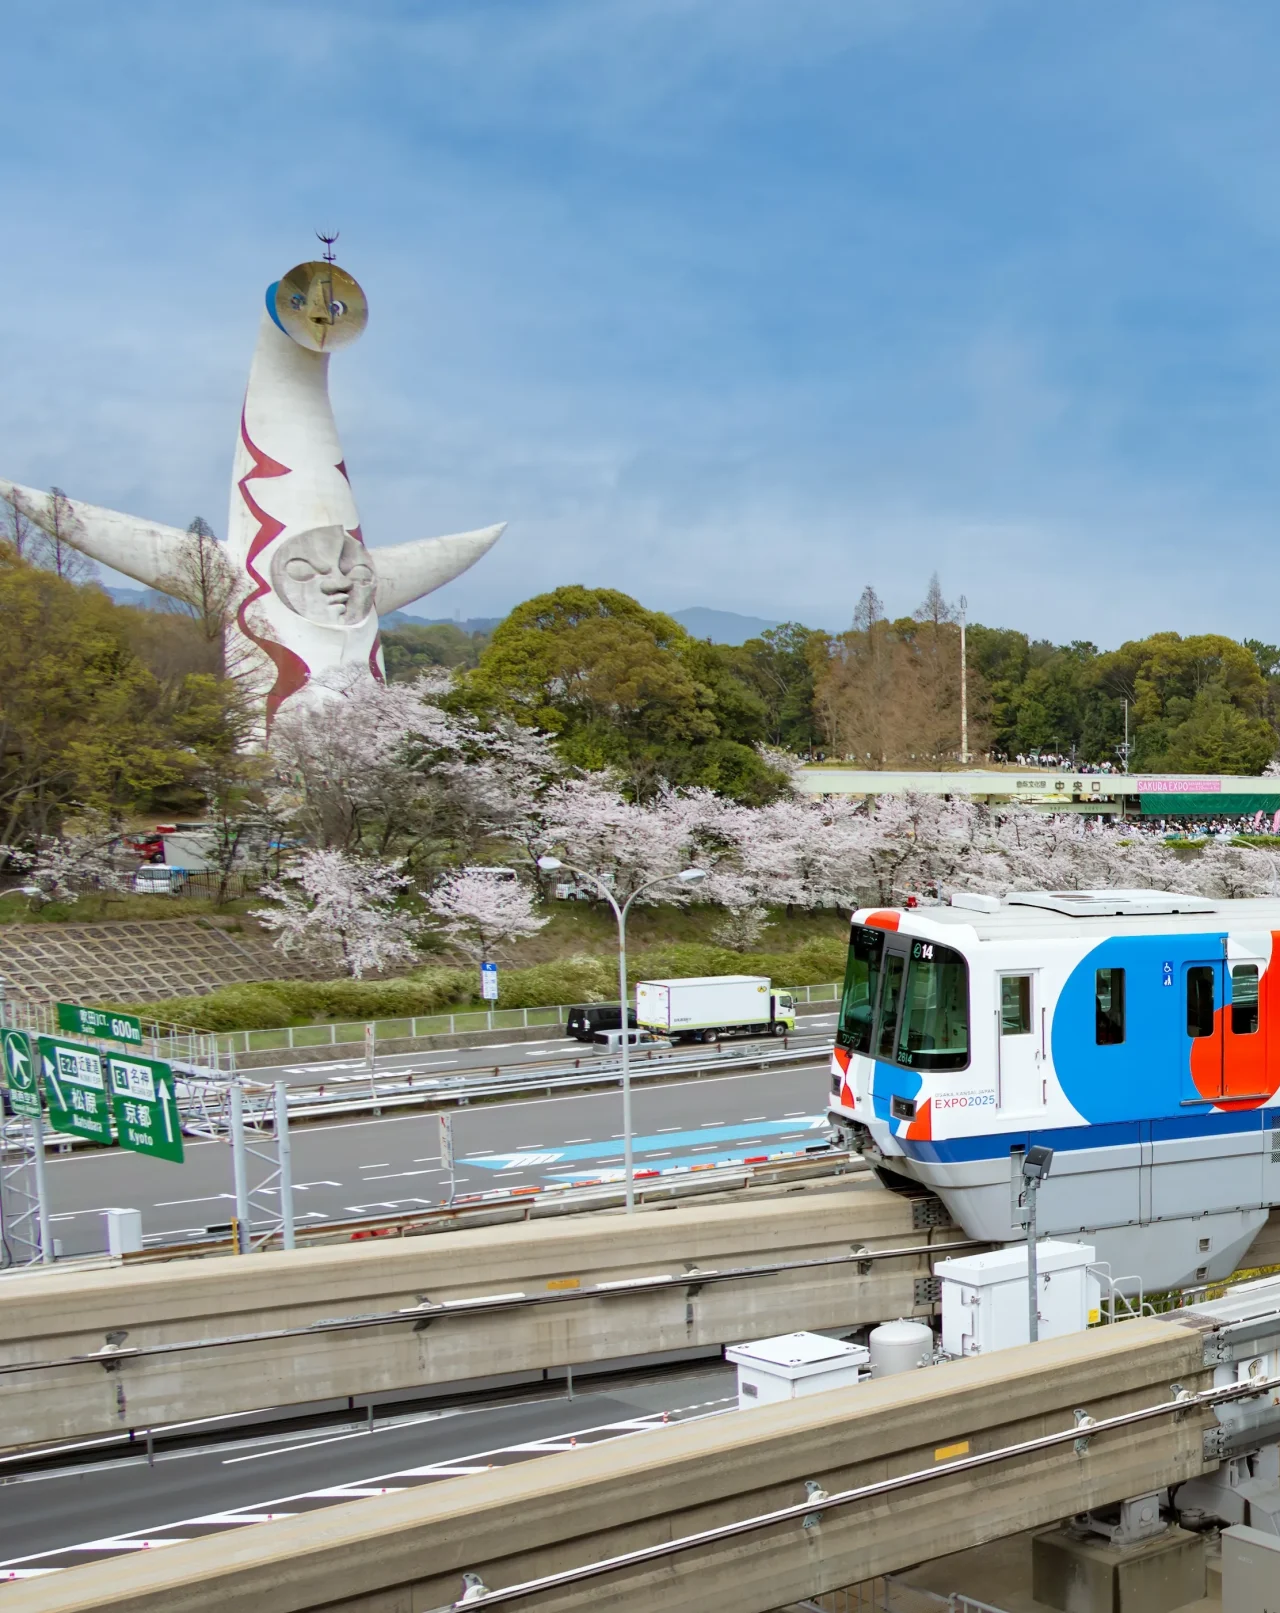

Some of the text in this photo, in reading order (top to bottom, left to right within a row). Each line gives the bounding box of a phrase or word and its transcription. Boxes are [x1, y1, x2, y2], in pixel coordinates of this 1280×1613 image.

[1055, 781, 1100, 792] 中央口
[1138, 781, 1168, 791] SAKURA
[1169, 781, 1189, 791] EXPO
[922, 944, 934, 959] 14
[111, 1018, 140, 1039] 600m
[60, 1057, 77, 1074] E26
[898, 1051, 913, 1064] 2614
[115, 1070, 127, 1087] E1
[130, 1068, 149, 1084] 名神
[71, 1087, 98, 1114] 松原
[934, 1095, 995, 1109] EXPO2025
[123, 1102, 152, 1128] 京都
[128, 1128, 154, 1146] Kyoto
